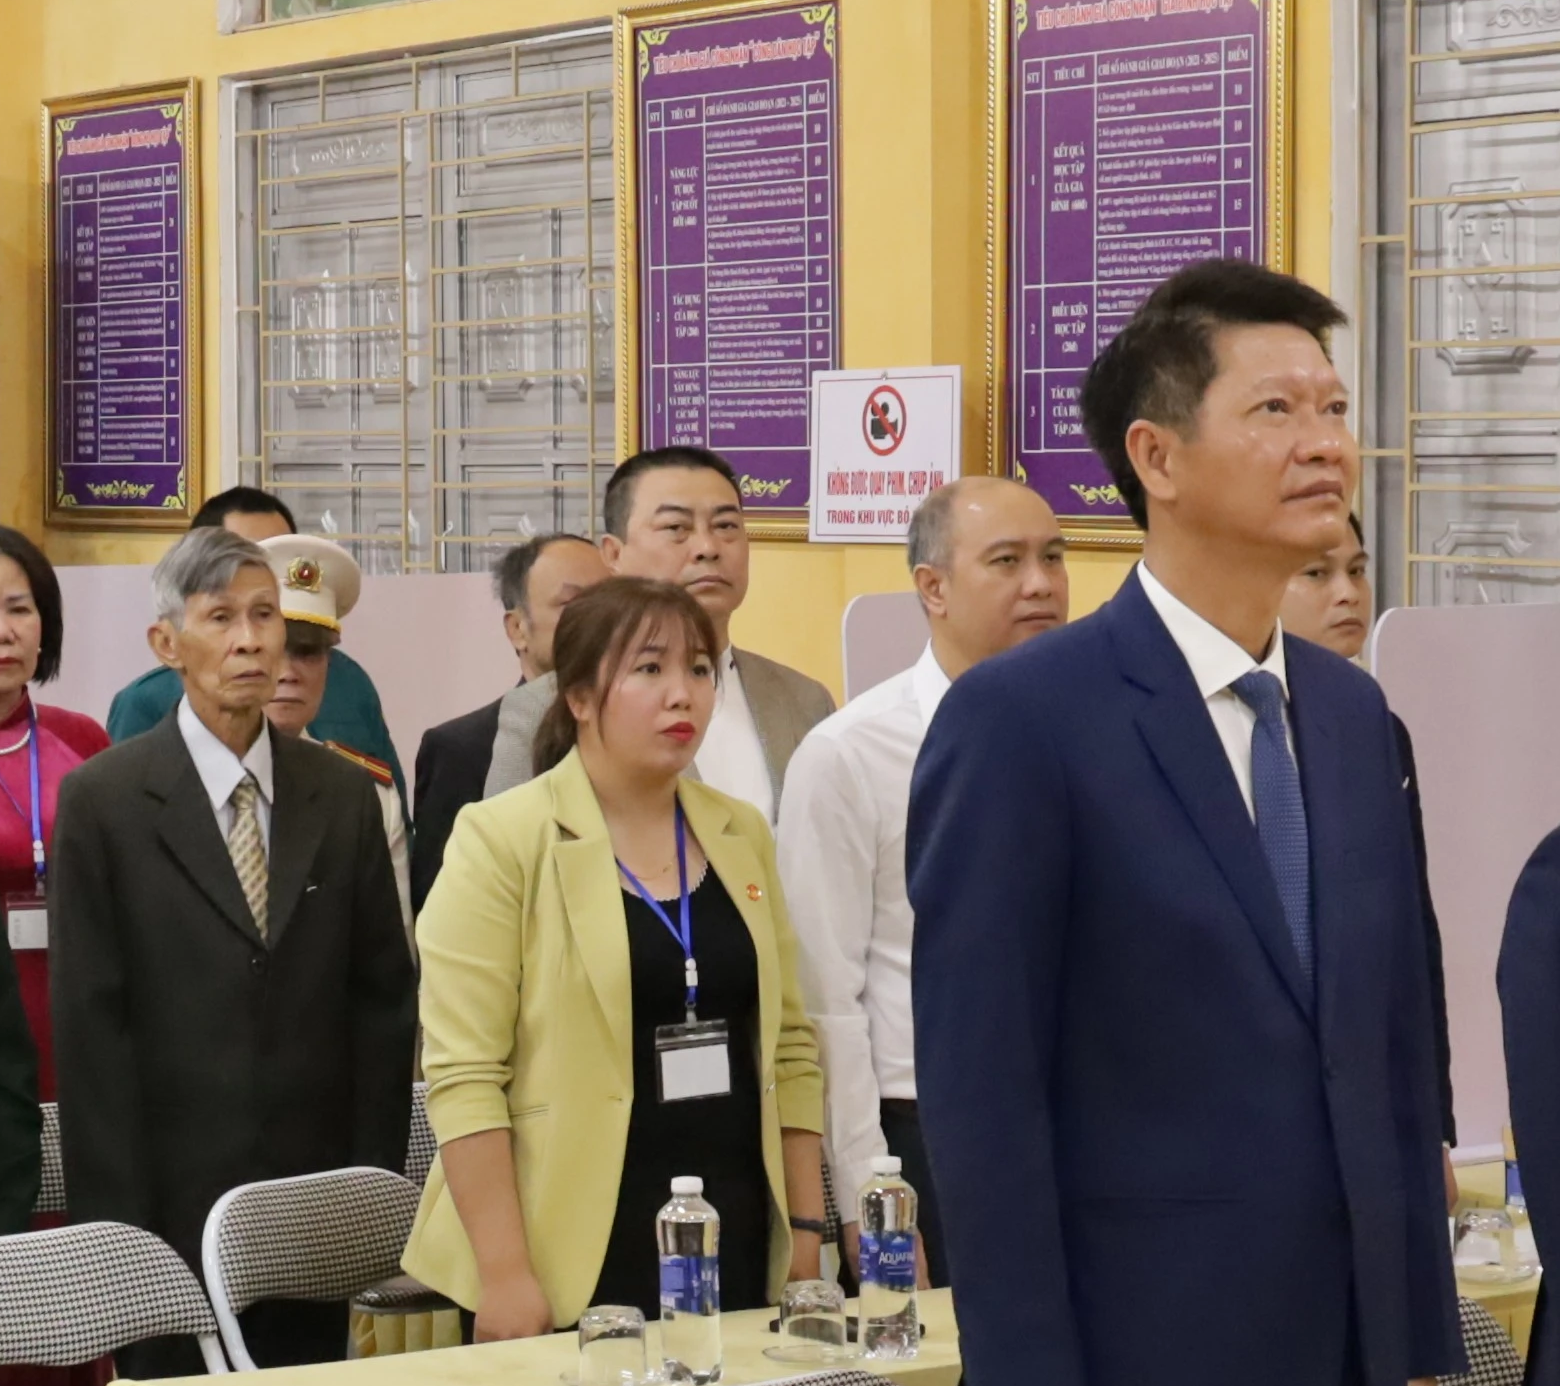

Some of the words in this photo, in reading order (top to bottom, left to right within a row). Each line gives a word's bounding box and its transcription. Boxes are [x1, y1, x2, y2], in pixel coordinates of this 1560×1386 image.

[827, 466, 849, 495] KHÔNG
[851, 469, 867, 501] ĐƯỢC
[870, 471, 885, 498] QUAY
[908, 471, 927, 501] CHỤP
[826, 510, 855, 524] TRONG
[857, 510, 874, 524] KHU
[878, 509, 894, 527] VỰC
[897, 505, 909, 524] BỎ
